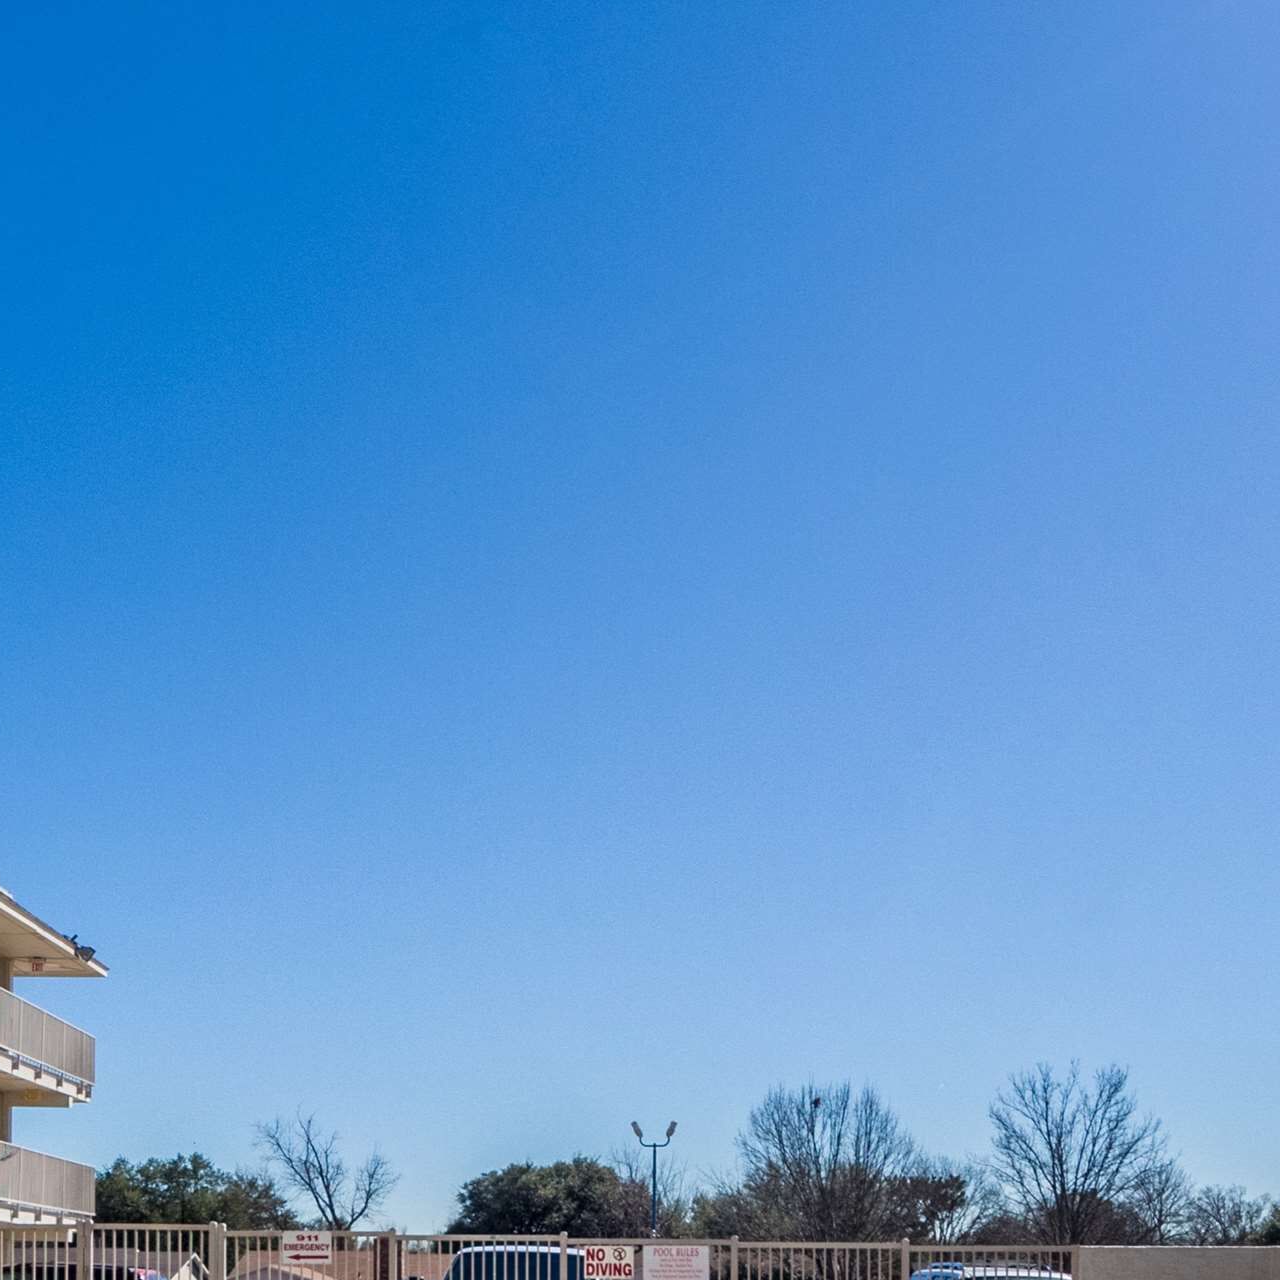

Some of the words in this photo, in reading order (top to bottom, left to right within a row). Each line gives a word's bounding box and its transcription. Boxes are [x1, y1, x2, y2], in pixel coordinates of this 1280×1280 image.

[296, 1234, 319, 1242] 911
[283, 1243, 330, 1252] EMERGENCY
[653, 1247, 673, 1257] POOL
[676, 1247, 700, 1257] RULES
[586, 1248, 606, 1262] NO
[586, 1263, 633, 1276] DIVING
